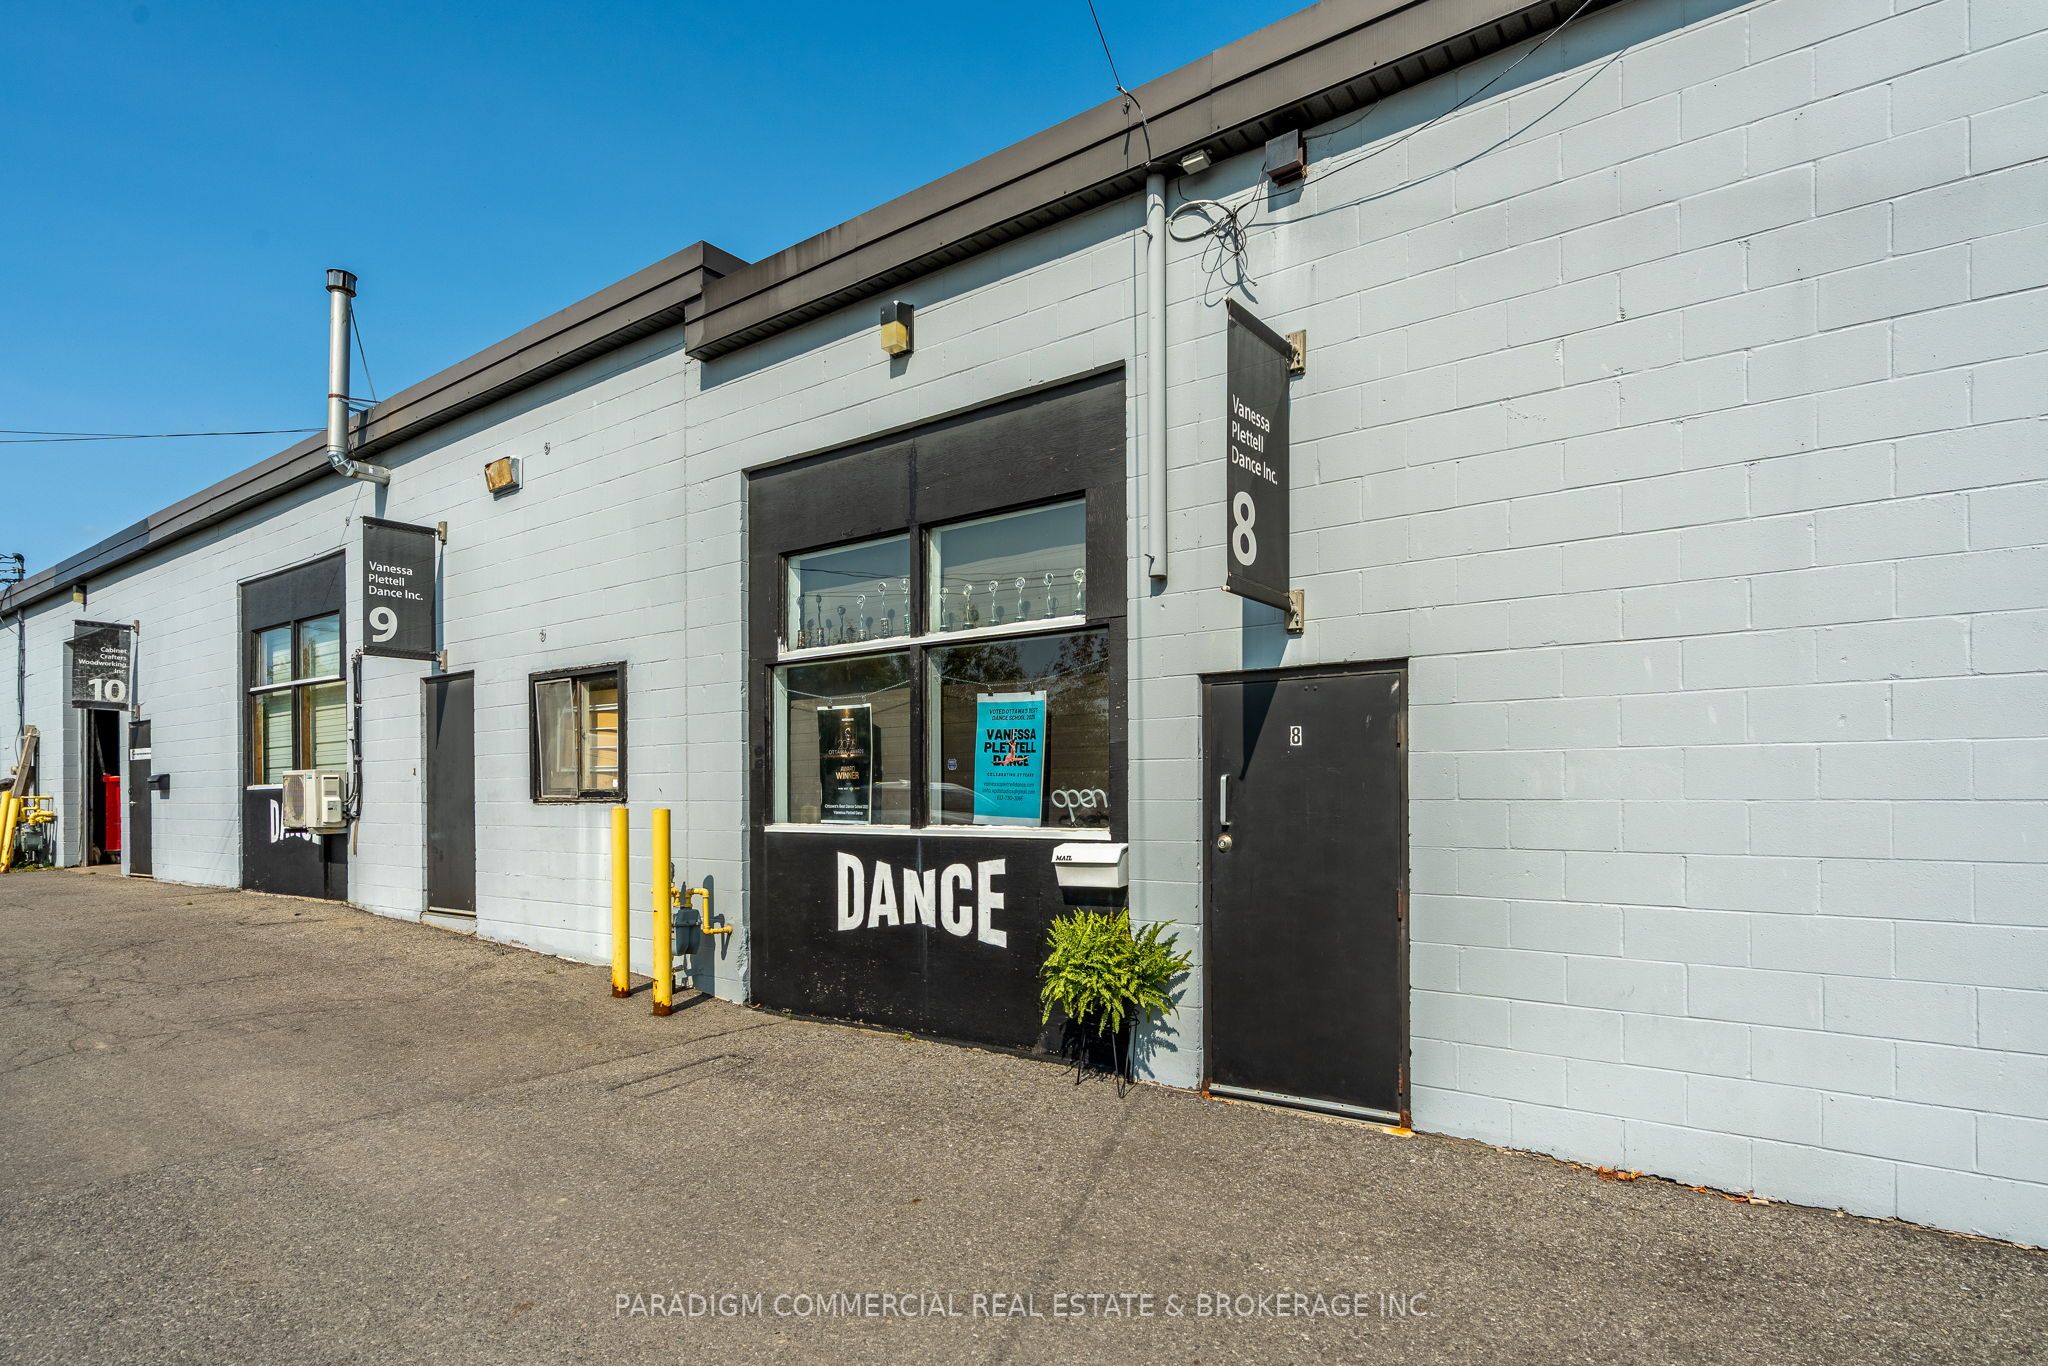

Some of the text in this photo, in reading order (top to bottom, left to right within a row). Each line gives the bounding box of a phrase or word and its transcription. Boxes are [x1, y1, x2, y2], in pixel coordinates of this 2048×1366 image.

[1232, 394, 1270, 433] Vanessa
[1231, 420, 1264, 453] Plettell
[1231, 445, 1278, 485] Dance Inc.
[1232, 491, 1257, 566] 8
[369, 561, 413, 576] Vanessa
[368, 574, 405, 586] Plettell
[368, 585, 424, 601] Dance Inc.
[369, 606, 398, 643] 9
[100, 646, 127, 654] Cabinet
[100, 653, 127, 661] Crafters
[78, 658, 127, 668] Woodworking
[88, 678, 126, 702] 10
[986, 728, 1036, 740] VANESSA
[1291, 727, 1301, 745] 8
[984, 741, 1036, 753] PLETTELL
[835, 771, 859, 780] WINNER
[1051, 789, 1108, 823] open
[837, 851, 1007, 948] DANCE
